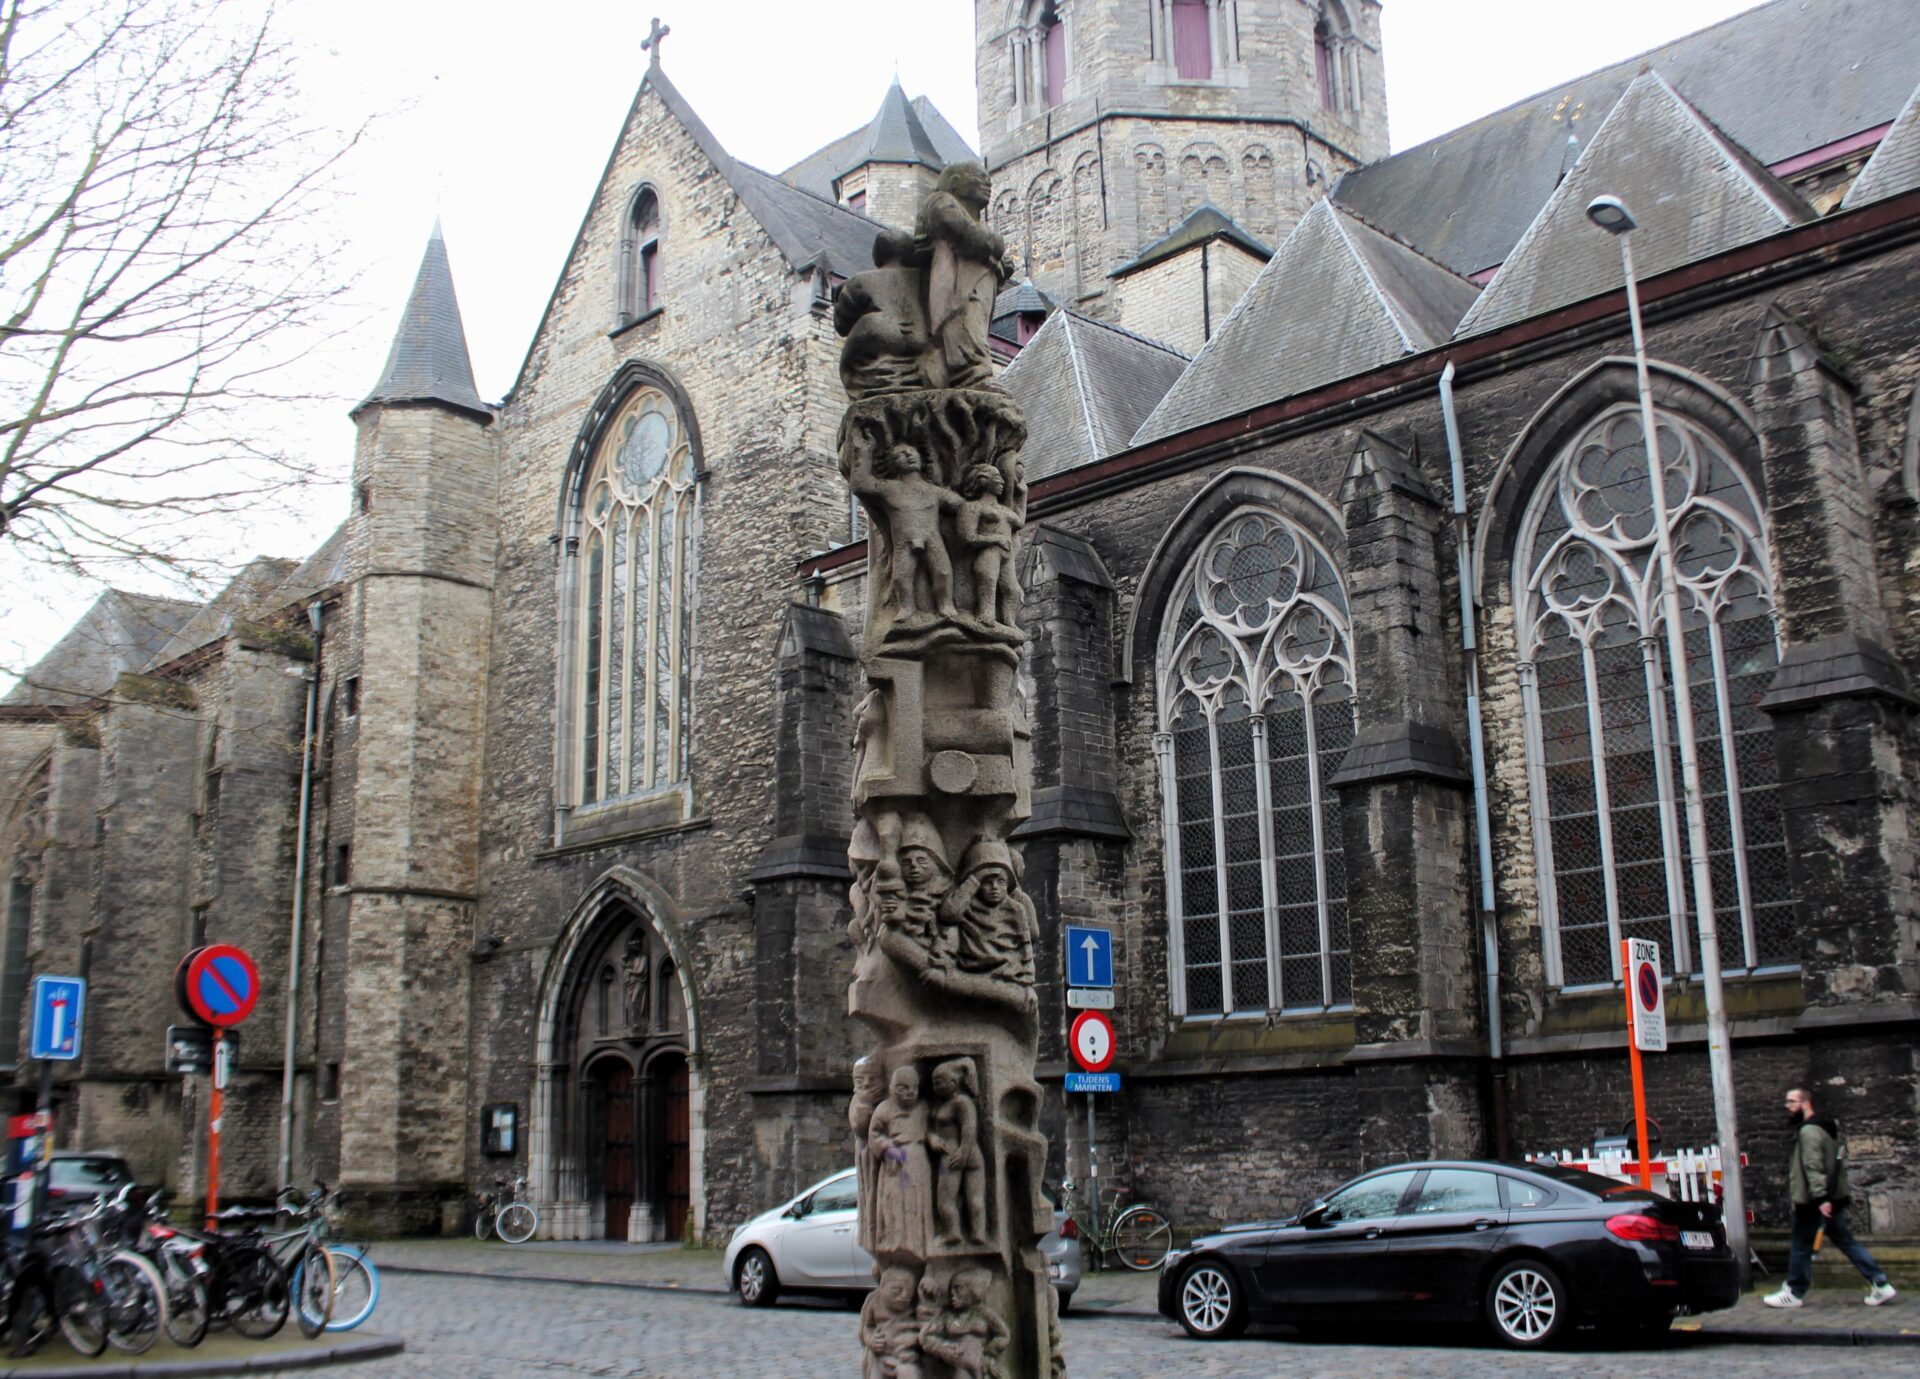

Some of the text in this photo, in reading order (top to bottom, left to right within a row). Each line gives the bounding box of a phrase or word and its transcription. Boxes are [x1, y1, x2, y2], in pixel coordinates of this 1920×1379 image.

[1636, 943, 1656, 962] ZONE
[1078, 1075, 1110, 1084] TIJDENS
[1074, 1083, 1113, 1092] MARKTEN
